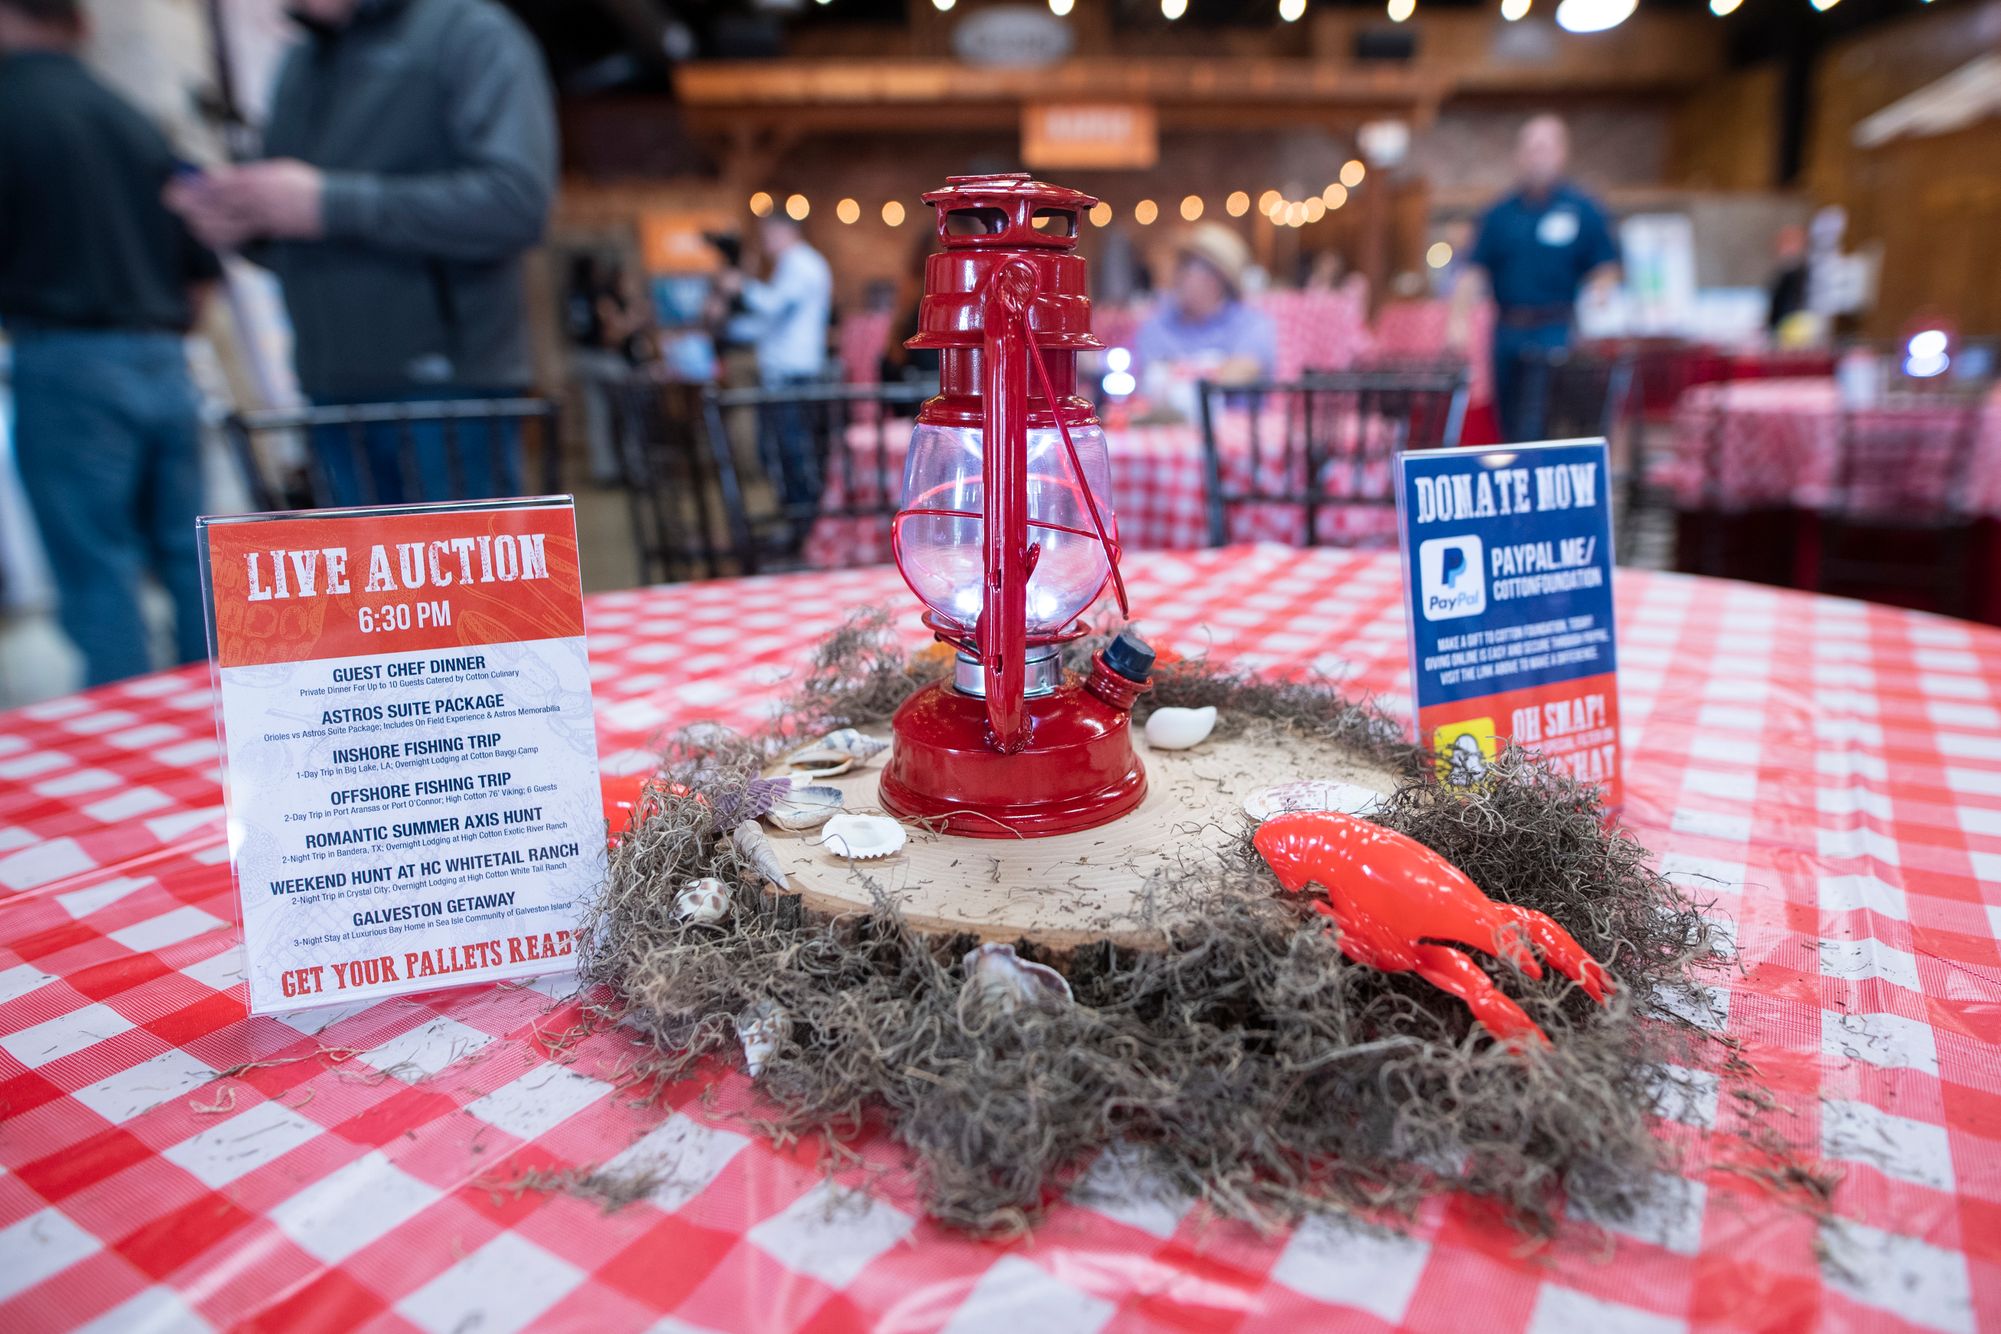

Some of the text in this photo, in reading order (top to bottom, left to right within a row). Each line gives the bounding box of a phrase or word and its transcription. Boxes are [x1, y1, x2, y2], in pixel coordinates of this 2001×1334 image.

[1414, 462, 1597, 524] DONATE NOW
[245, 533, 549, 602] LIVE AUCTION
[1491, 535, 1596, 576] PAYPAL.ME/
[1429, 591, 1478, 611] PayPal
[1493, 567, 1602, 601] COTTONFOUNDATION
[358, 600, 451, 633] 6:30 PM
[300, 688, 326, 697] Private
[328, 686, 351, 694] Dinner
[354, 684, 365, 692] For
[368, 682, 378, 692] Up
[389, 680, 398, 688] 10
[399, 678, 424, 687] Guests
[426, 676, 453, 685] Catered
[456, 674, 464, 683] by
[466, 672, 489, 681] Cotton
[491, 670, 520, 678] Culinary
[333, 656, 486, 682] GUEST CHEF DINNER
[264, 732, 290, 742] Orioles
[302, 729, 326, 738] Astros
[328, 726, 347, 736] Suite
[348, 724, 382, 734] Package;
[383, 720, 413, 730] Includes
[427, 716, 444, 725] Field
[446, 713, 485, 723] Experience
[494, 709, 516, 718] Astros
[518, 705, 560, 716] Memorabilia
[322, 694, 504, 725] ASTROS SUITE PACKAGE
[1512, 706, 1541, 743] OH
[1544, 694, 1606, 737] SNAP!
[297, 770, 318, 780] 1-Day
[321, 768, 334, 778] Trip
[345, 765, 357, 775] Big
[359, 764, 379, 772] Lake,
[380, 762, 393, 770] LA;
[395, 758, 430, 769] Overnight
[431, 754, 459, 764] Lodging
[461, 753, 468, 761] at
[470, 752, 493, 760] Cotton
[495, 749, 516, 757] Bayou
[518, 746, 539, 755] Camp
[333, 733, 501, 764] INSHORE FISHING TRIP
[284, 812, 307, 822] 2-Day
[309, 810, 322, 820] Trip
[324, 809, 332, 817] in
[334, 808, 349, 816] Port
[351, 804, 380, 814] Aransas
[391, 801, 407, 810] Port
[409, 797, 444, 808] O'Connor;
[446, 795, 462, 804] High
[464, 792, 487, 801] Cotton
[489, 790, 500, 798] 76'
[502, 788, 526, 797] Viking;
[527, 786, 532, 794] 6
[534, 783, 557, 792] Guests
[331, 772, 511, 805] OFFSHORE FISHING TRIP
[282, 853, 310, 864] 2-Night
[312, 852, 326, 861] Trip
[336, 847, 369, 857] Bandera,
[371, 845, 384, 853] TX;
[386, 841, 420, 851] Overnight
[422, 836, 451, 847] Lodging
[461, 833, 477, 842] High
[479, 830, 502, 839] Cotton
[504, 828, 525, 836] Exotic
[527, 825, 544, 833] River
[546, 822, 568, 831] Ranch
[306, 807, 542, 849] ROMANTIC SUMMER AXIS HUNT
[270, 842, 579, 896] WEEKEND HUNT AT HC WHITETAIL RANCH
[292, 895, 321, 905] 2-Night
[322, 893, 336, 902] Trip
[348, 888, 372, 898] Crystal
[374, 885, 391, 895] City;
[392, 882, 427, 892] Overnight
[429, 876, 457, 887] Lodging
[467, 873, 484, 882] High
[485, 870, 508, 879] Cotton
[510, 867, 530, 876] White
[532, 865, 544, 873] Tail
[545, 862, 567, 871] Ranch
[294, 902, 572, 947] 3-Night Stay at Luxurious Bay Home in Sea Isle Community of Galveston Island
[353, 891, 516, 927] GALVESTON GETAWAY
[281, 966, 324, 998] GET
[331, 956, 400, 990] YOUR
[404, 939, 503, 979] PALLETS
